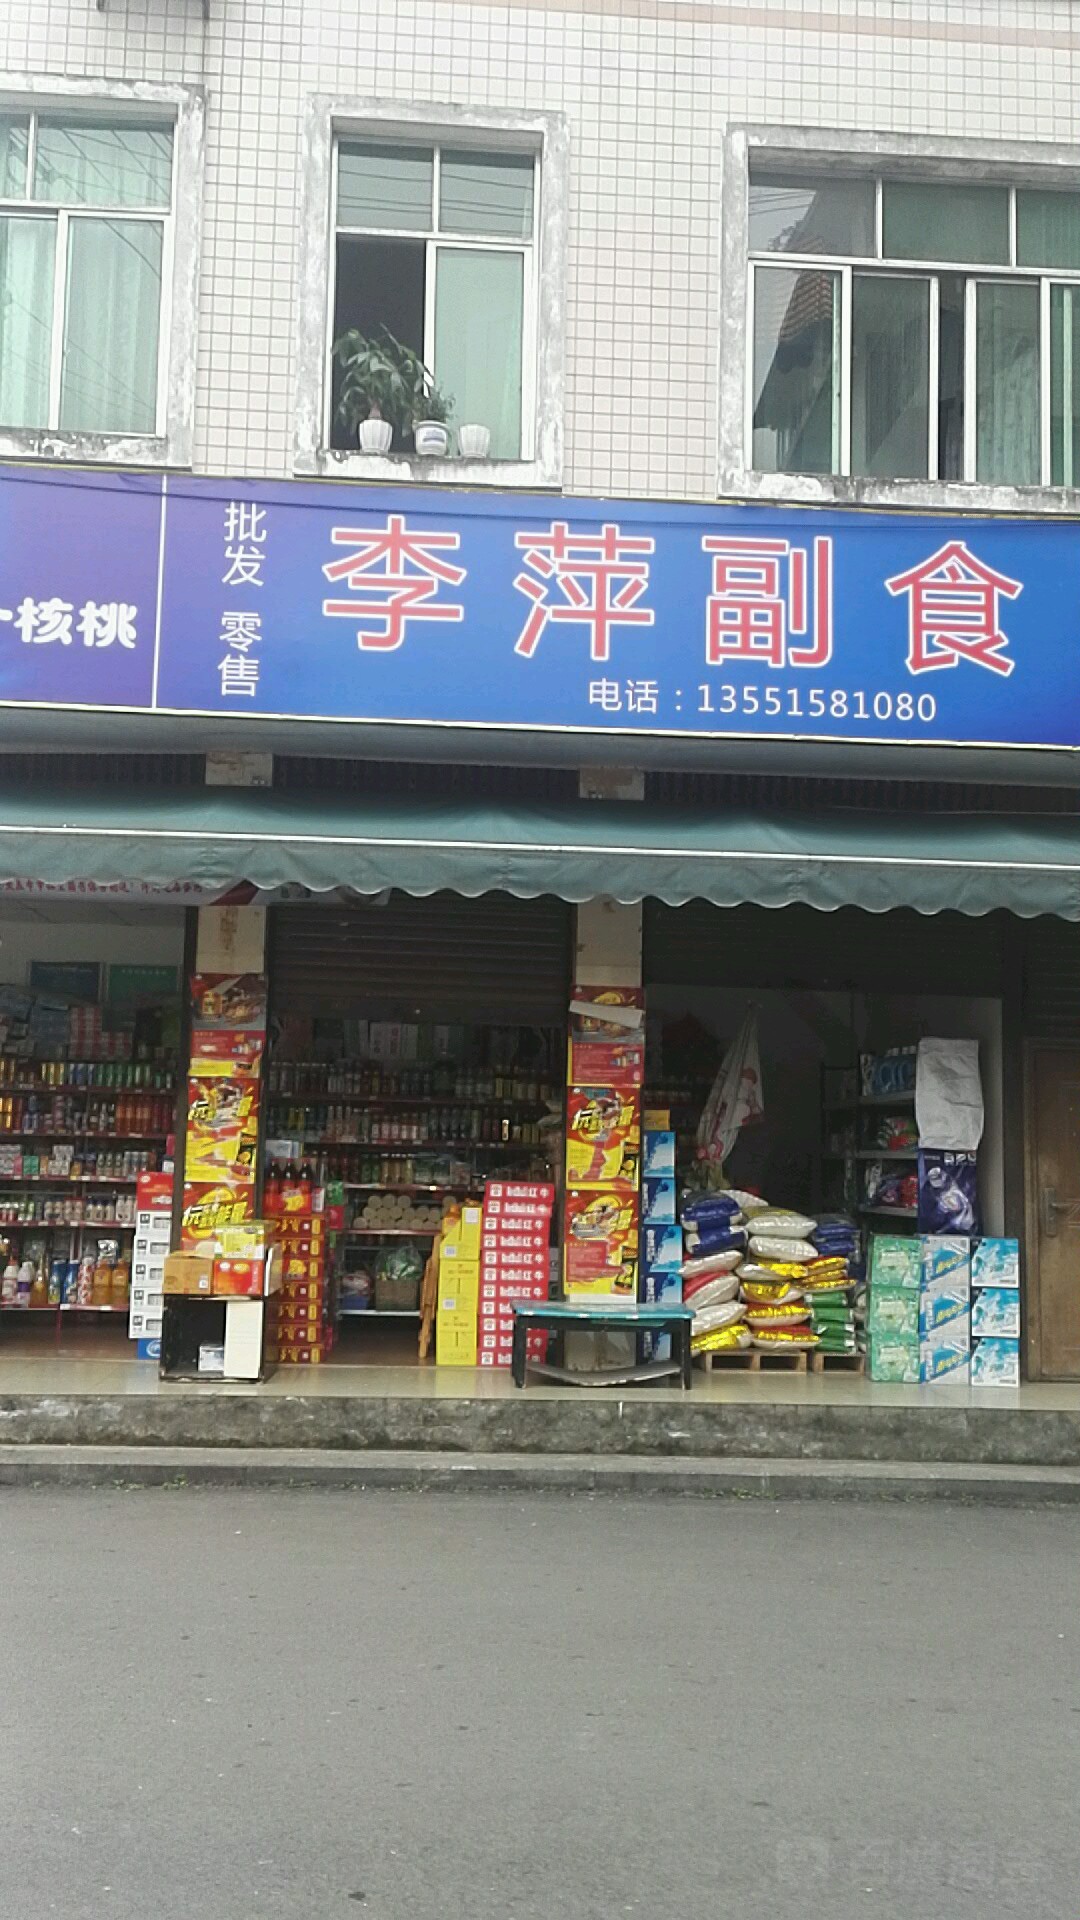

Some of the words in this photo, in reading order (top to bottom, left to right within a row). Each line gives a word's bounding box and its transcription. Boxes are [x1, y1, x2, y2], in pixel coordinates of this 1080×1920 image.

[221, 501, 267, 587] 批发
[0, 597, 138, 649] 核桃
[321, 513, 1024, 678] 李萍副食
[217, 611, 262, 697] 零售
